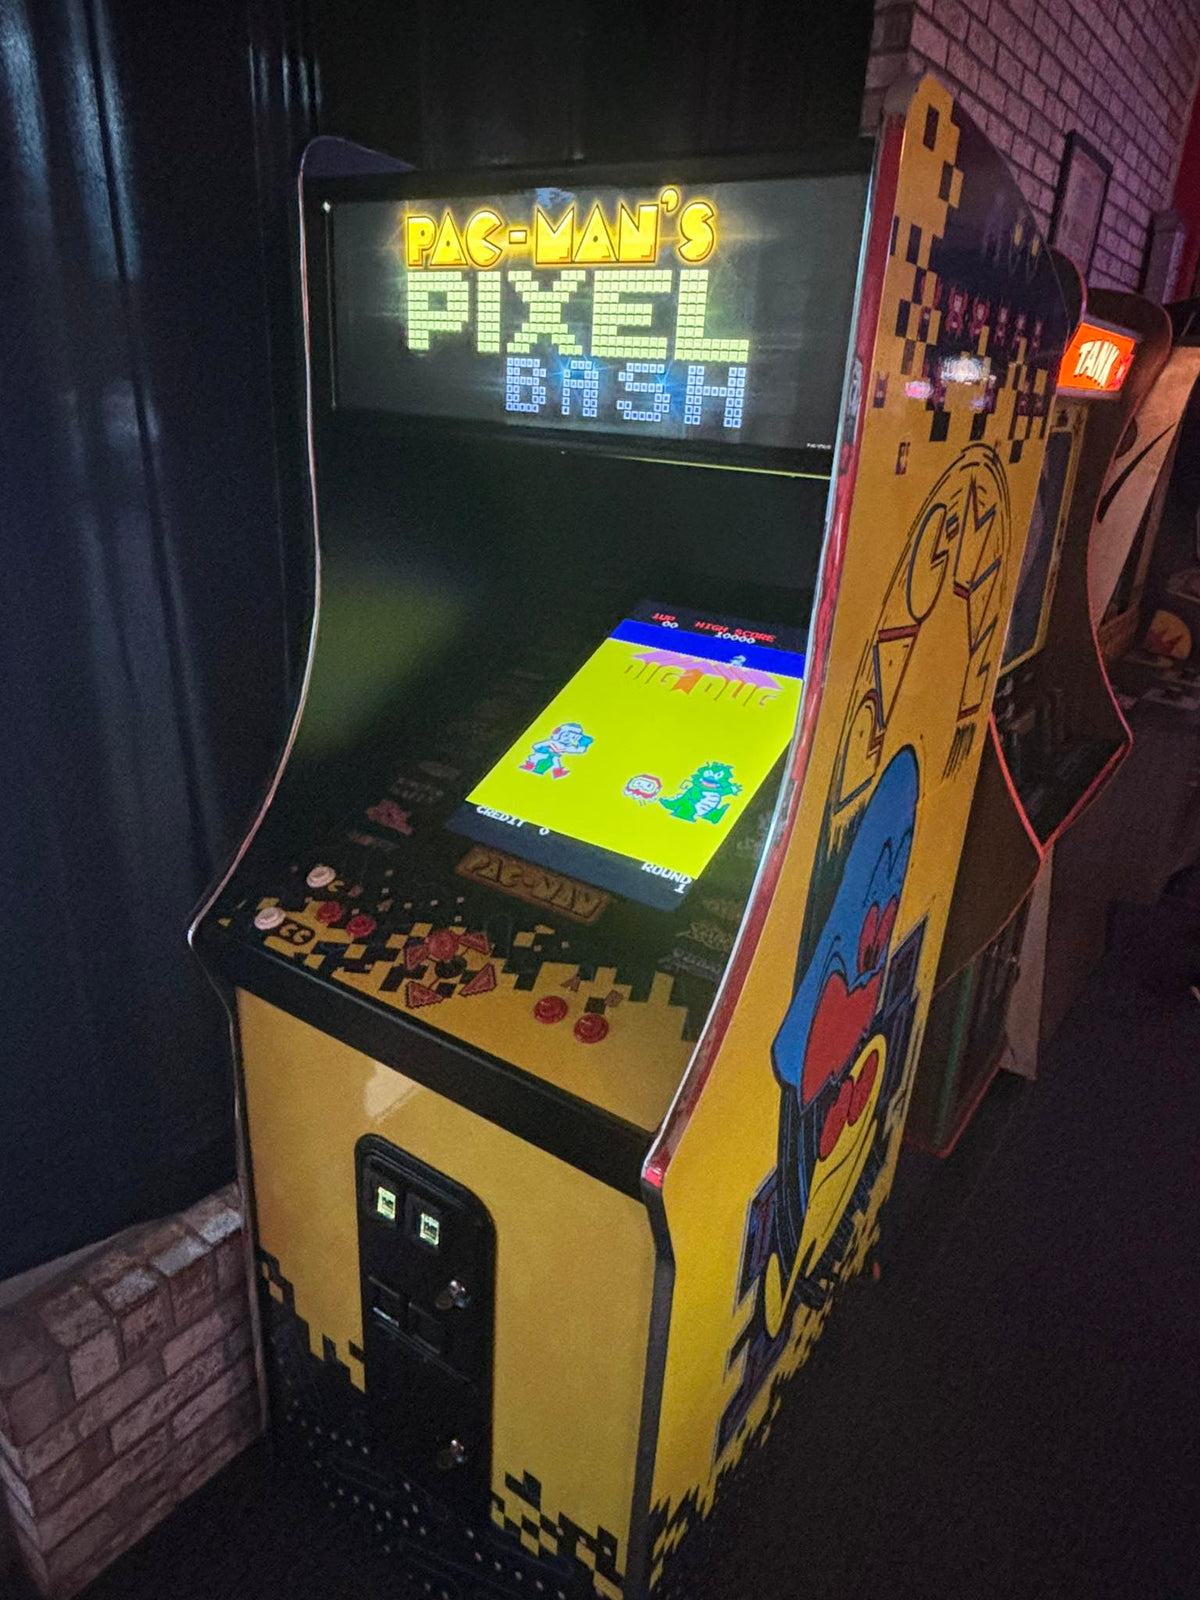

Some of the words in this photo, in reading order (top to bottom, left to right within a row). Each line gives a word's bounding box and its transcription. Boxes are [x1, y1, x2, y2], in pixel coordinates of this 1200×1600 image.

[406, 184, 716, 268] PAC-MAN'S
[406, 269, 750, 363] PIXEL
[1073, 339, 1120, 388] TANK
[505, 357, 746, 428] BASH
[653, 613, 676, 622] 1UP
[662, 621, 678, 629] 00
[695, 621, 728, 633] HIGH
[733, 629, 776, 642] SCORE
[715, 632, 756, 644] 10000
[623, 656, 687, 688] DIG
[693, 672, 780, 709] DUG
[476, 805, 526, 827] CREDIT
[538, 826, 550, 836] 0
[641, 860, 693, 885] ROUND
[674, 883, 686, 895] 1
